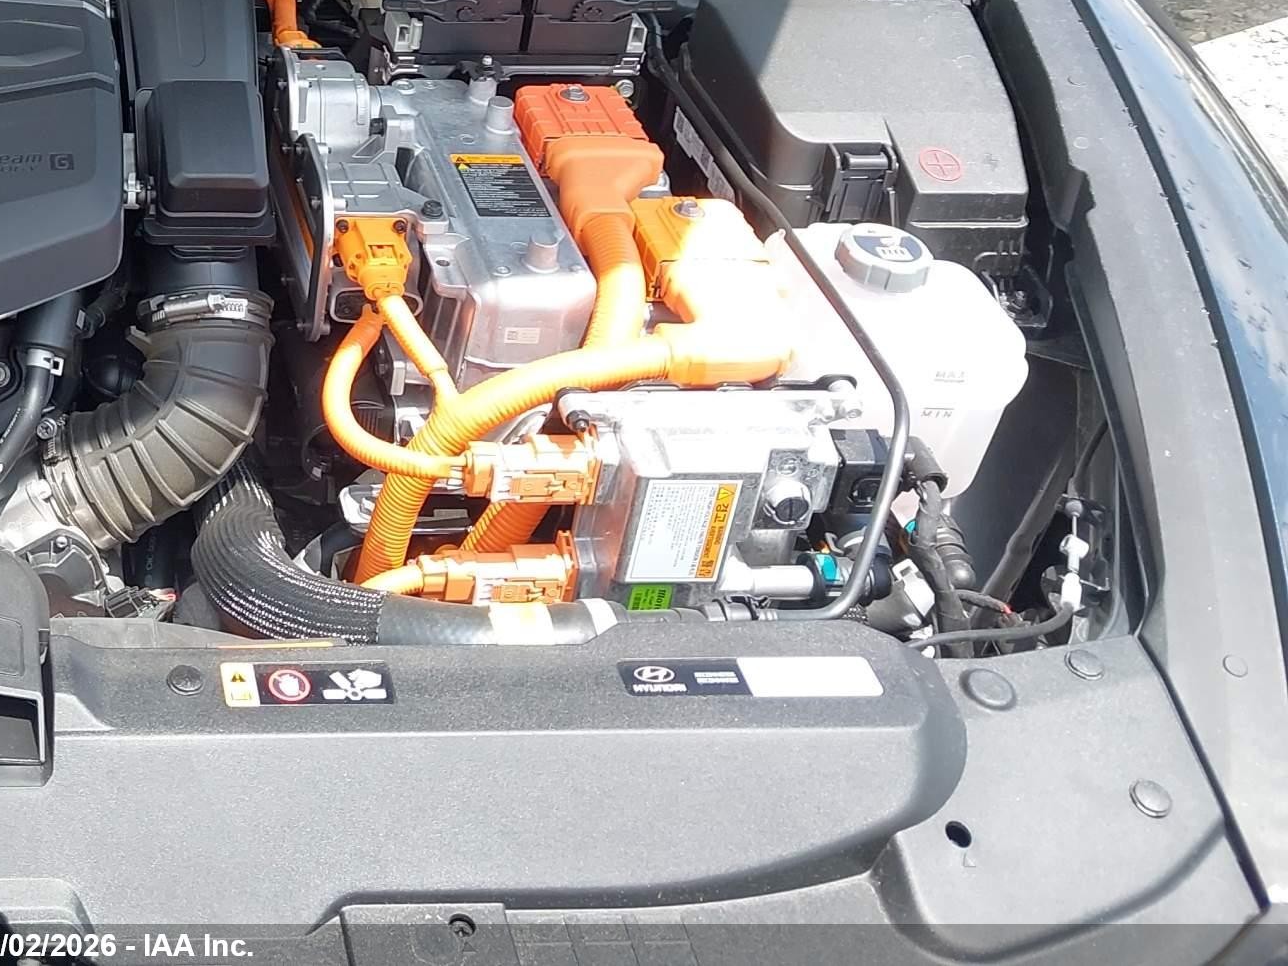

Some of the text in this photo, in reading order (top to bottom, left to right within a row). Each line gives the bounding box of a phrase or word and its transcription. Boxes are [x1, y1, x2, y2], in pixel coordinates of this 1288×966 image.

[920, 409, 953, 418] MIN
[713, 503, 729, 523] 경고
[632, 683, 688, 693] HYUNDAI
